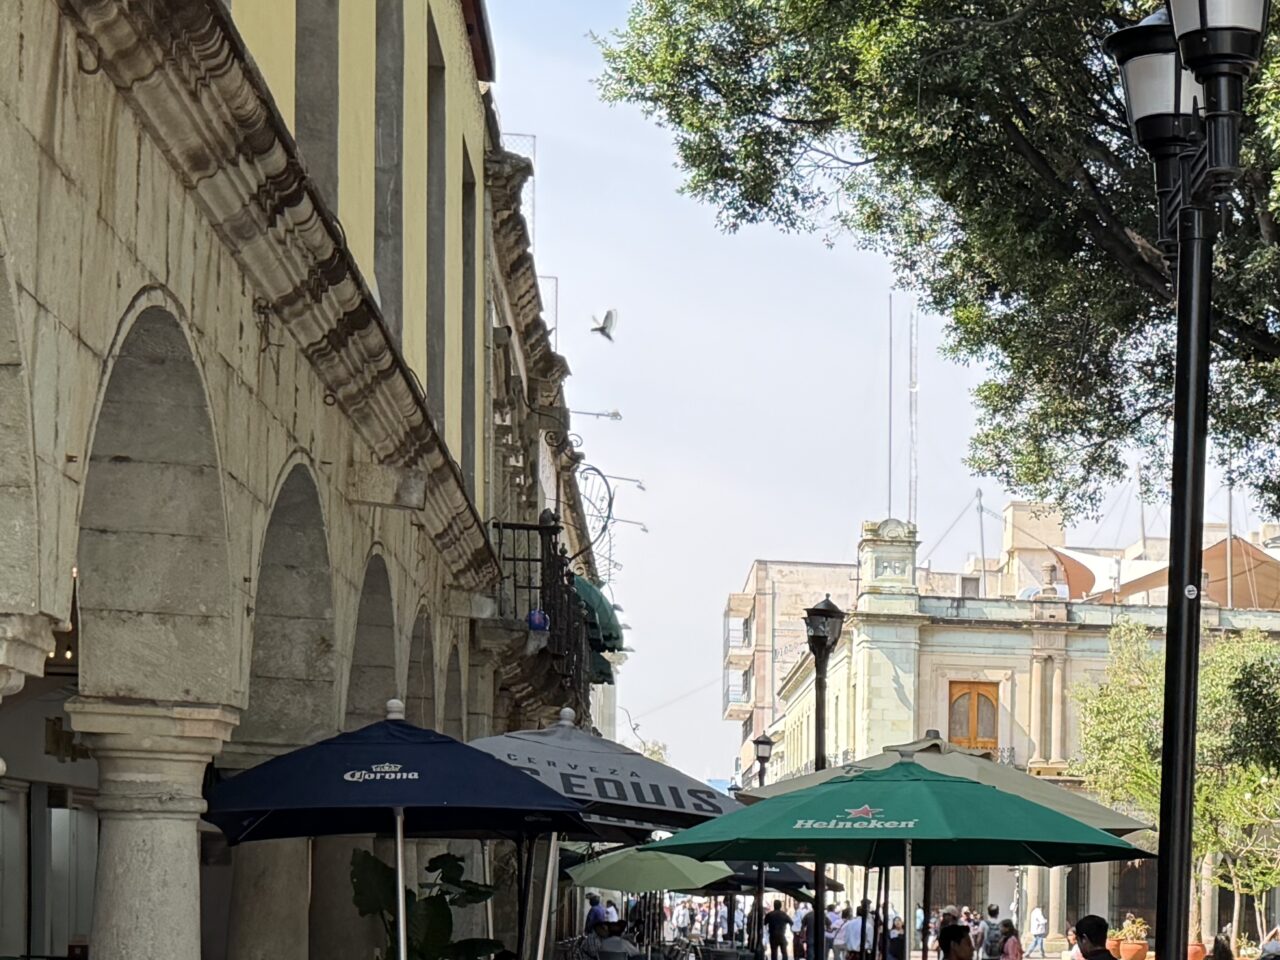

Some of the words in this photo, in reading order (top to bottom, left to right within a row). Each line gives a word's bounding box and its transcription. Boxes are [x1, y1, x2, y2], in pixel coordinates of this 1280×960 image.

[507, 753, 641, 778] CERVEZA
[344, 770, 419, 782] Corona
[559, 772, 723, 815] EQUIS
[793, 820, 915, 829] Heineken
